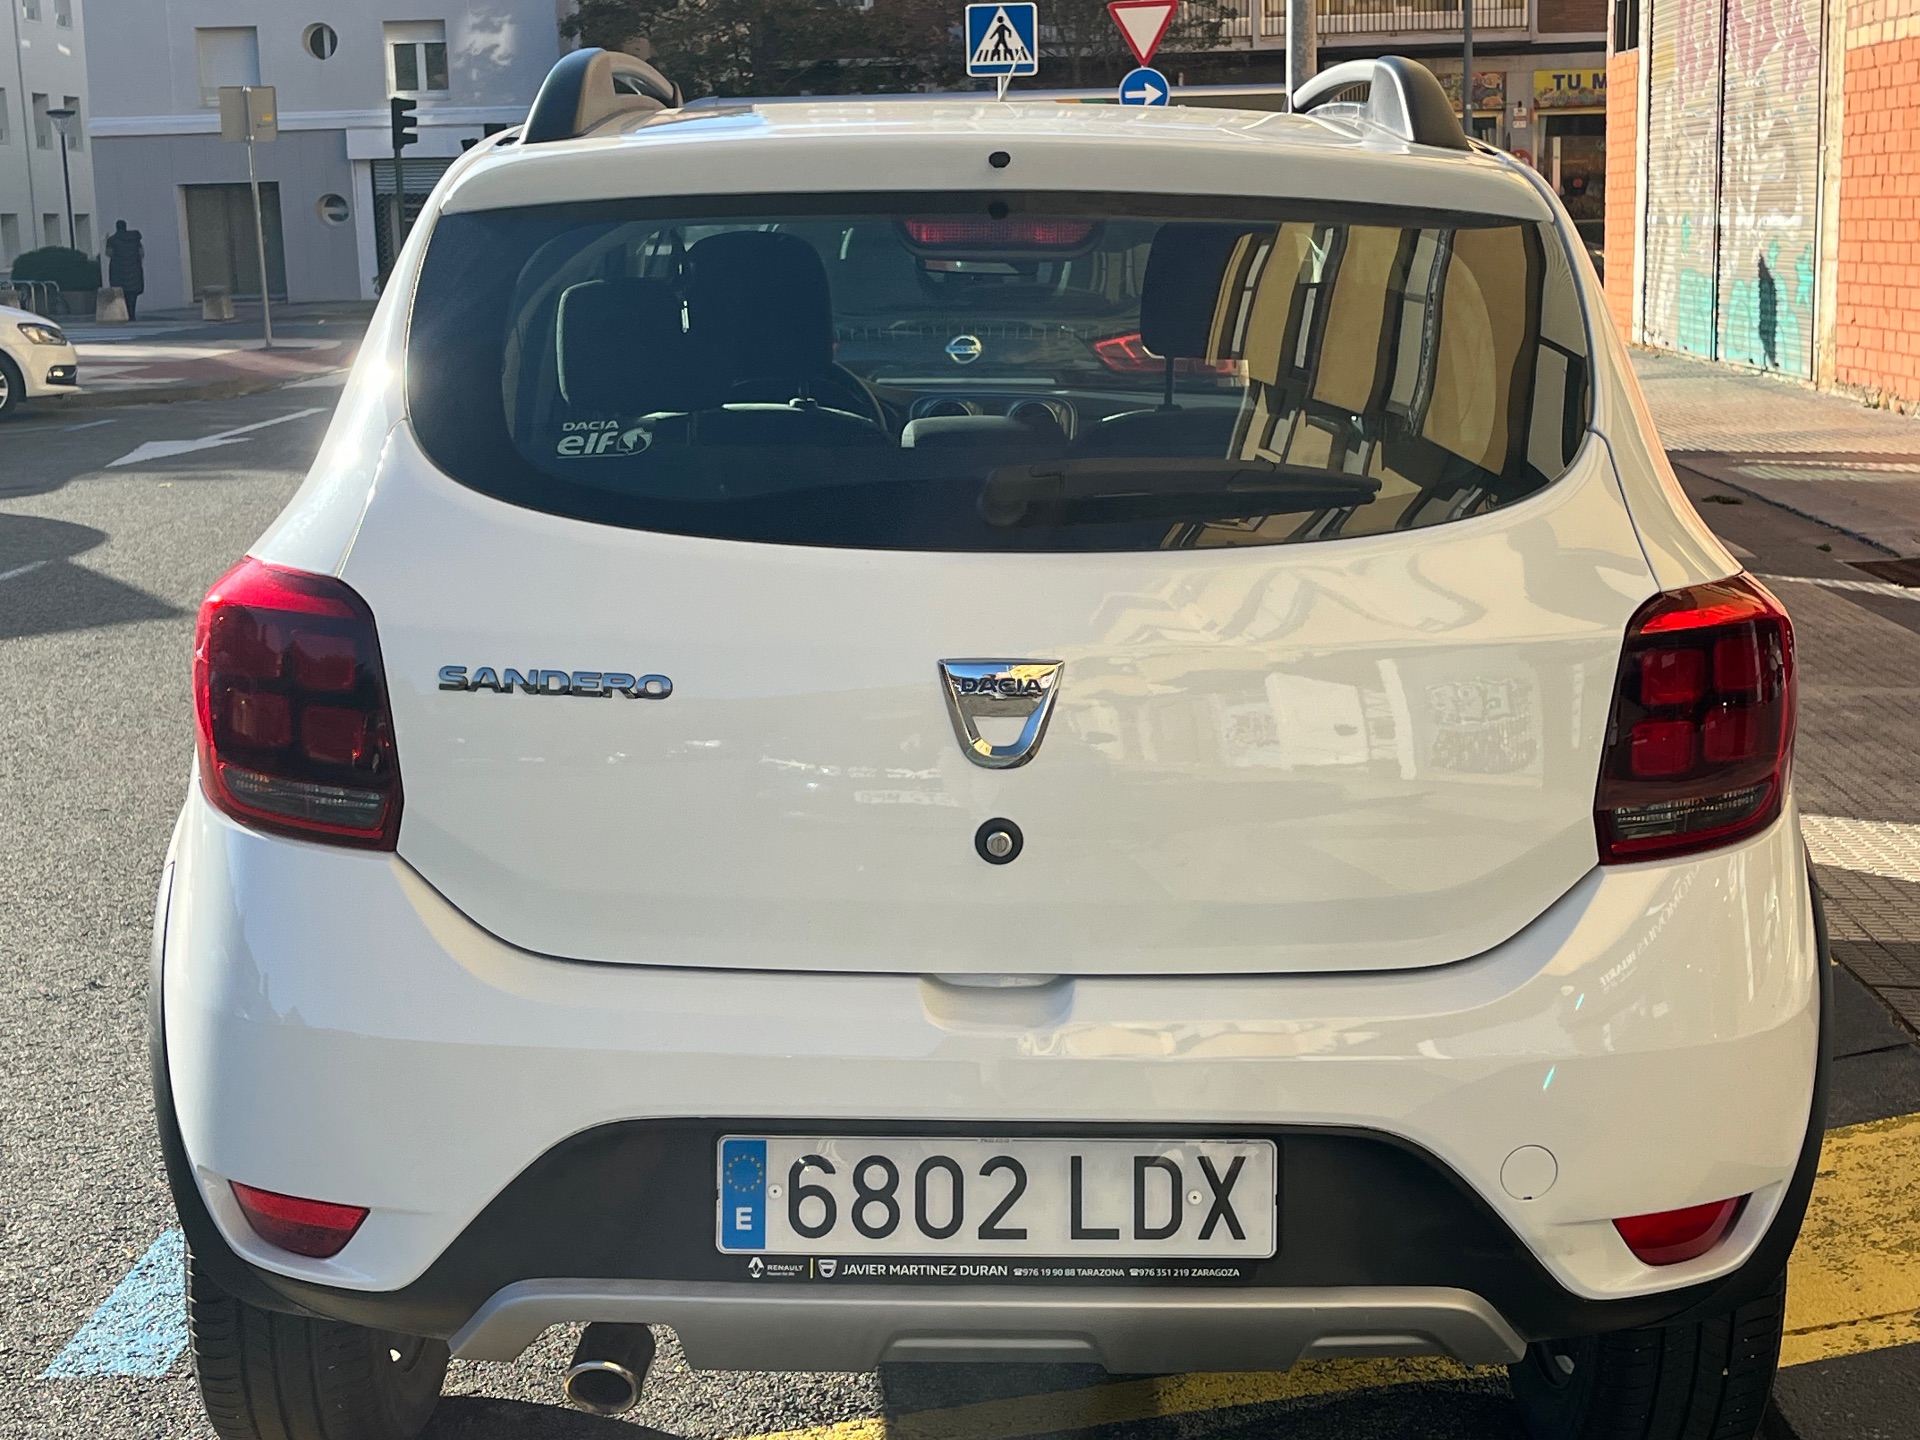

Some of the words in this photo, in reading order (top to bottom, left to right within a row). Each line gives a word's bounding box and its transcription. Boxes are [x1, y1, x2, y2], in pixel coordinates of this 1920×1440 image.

[1552, 74, 1581, 91] TU
[562, 420, 619, 431] DACIA
[557, 431, 618, 455] elf
[438, 665, 673, 699] SANDERO
[960, 677, 1042, 693] DACIA
[788, 1154, 1028, 1239] 6802
[1071, 1156, 1247, 1240] LDX
[736, 1207, 752, 1230] E
[766, 1264, 804, 1272] RENAULT
[841, 1264, 886, 1276] JAVIER
[889, 1264, 957, 1276] MARTINEZ
[959, 1265, 1008, 1276] DURAN
[1022, 1268, 1039, 1277] 976
[1040, 1268, 1052, 1277] 19
[1052, 1268, 1063, 1277] 90
[1077, 1268, 1125, 1277] TARAZONA
[1139, 1268, 1156, 1277] 976
[1156, 1268, 1171, 1277] 351
[1173, 1268, 1190, 1277] 219
[1191, 1268, 1240, 1277] ZARAGOZA
